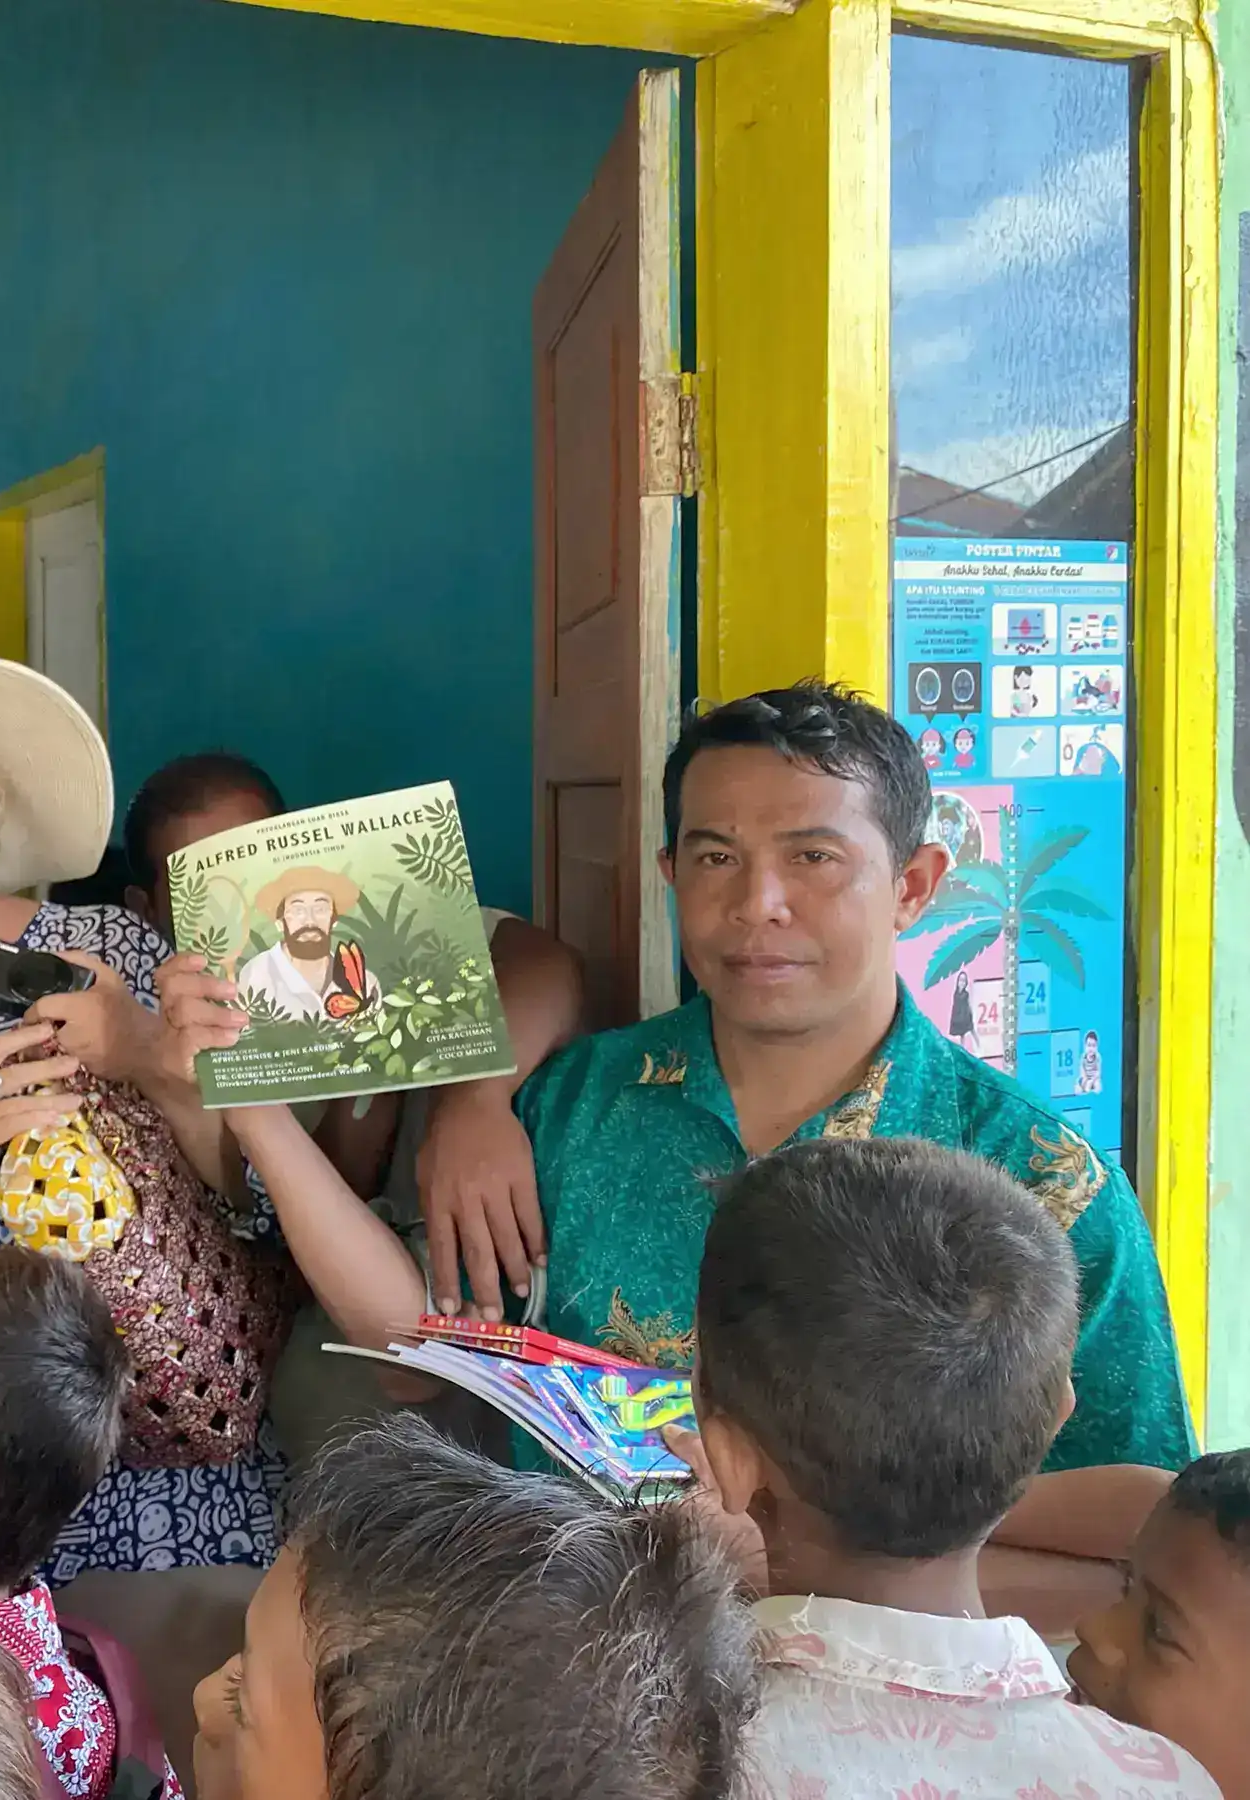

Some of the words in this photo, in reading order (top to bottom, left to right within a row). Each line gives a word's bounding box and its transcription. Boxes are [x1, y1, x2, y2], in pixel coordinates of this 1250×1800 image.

[195, 843, 258, 873] ALFRED
[266, 827, 334, 852] RUSSEL
[340, 809, 424, 837] WALLACE
[1025, 981, 1046, 1004] 24
[978, 1002, 998, 1025] 24
[426, 1034, 447, 1043] GITA
[448, 1027, 493, 1040] RACHMAN
[242, 1052, 273, 1060] DENISE
[282, 1048, 300, 1057] JENI
[439, 1051, 464, 1060] COCO
[465, 1046, 497, 1056] MELATI
[1004, 1049, 1017, 1063] 80
[1056, 1049, 1074, 1067] 18
[231, 1071, 264, 1080] GEORGE
[266, 1066, 313, 1078] BECCALONI
